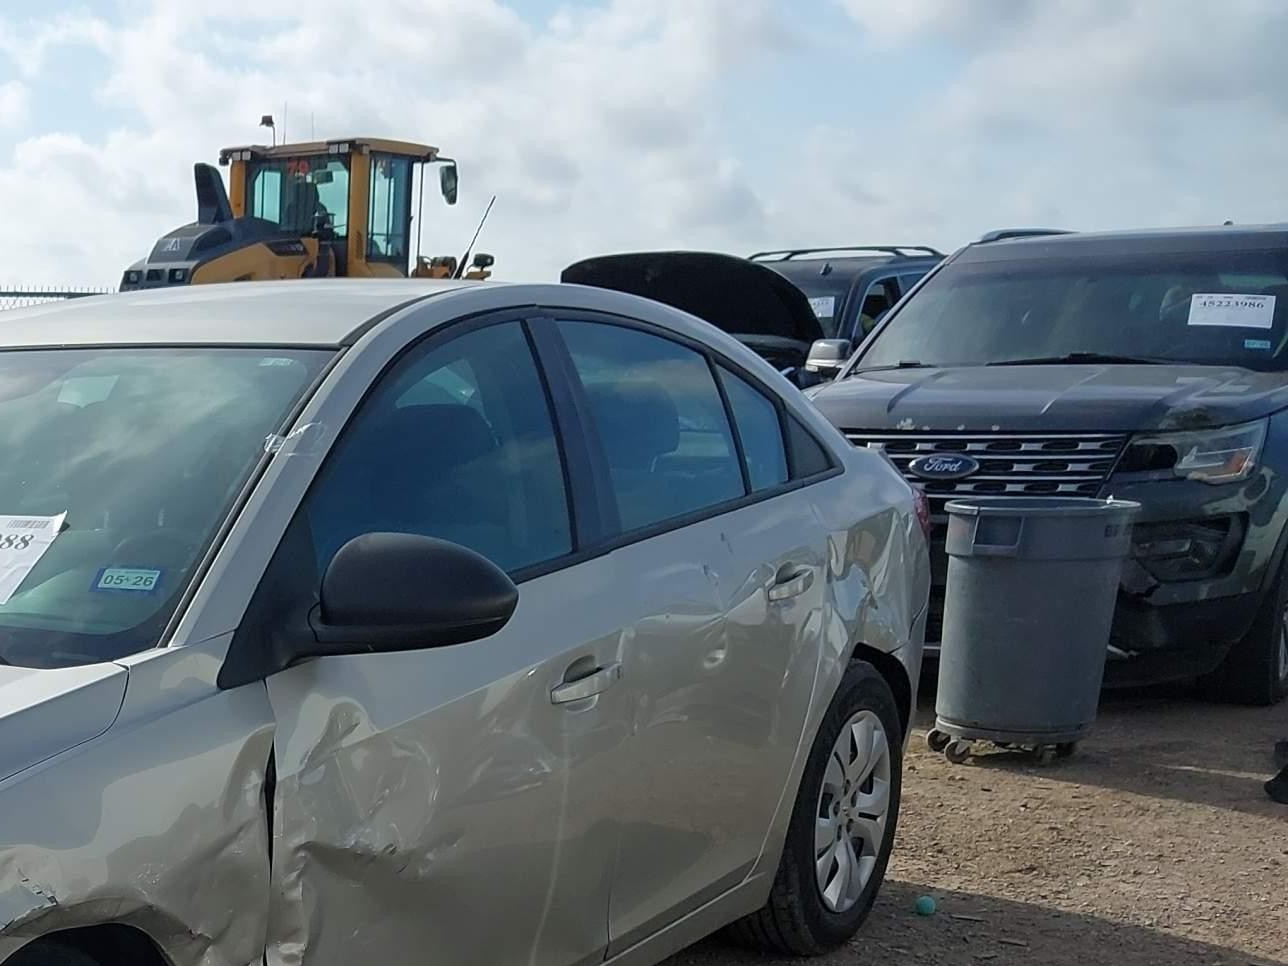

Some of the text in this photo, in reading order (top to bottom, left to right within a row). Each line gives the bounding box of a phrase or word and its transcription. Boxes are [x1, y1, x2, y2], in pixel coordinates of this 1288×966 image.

[1199, 301, 1265, 309] 45223986
[923, 457, 962, 472] Ford
[103, 575, 154, 586] 05 26
